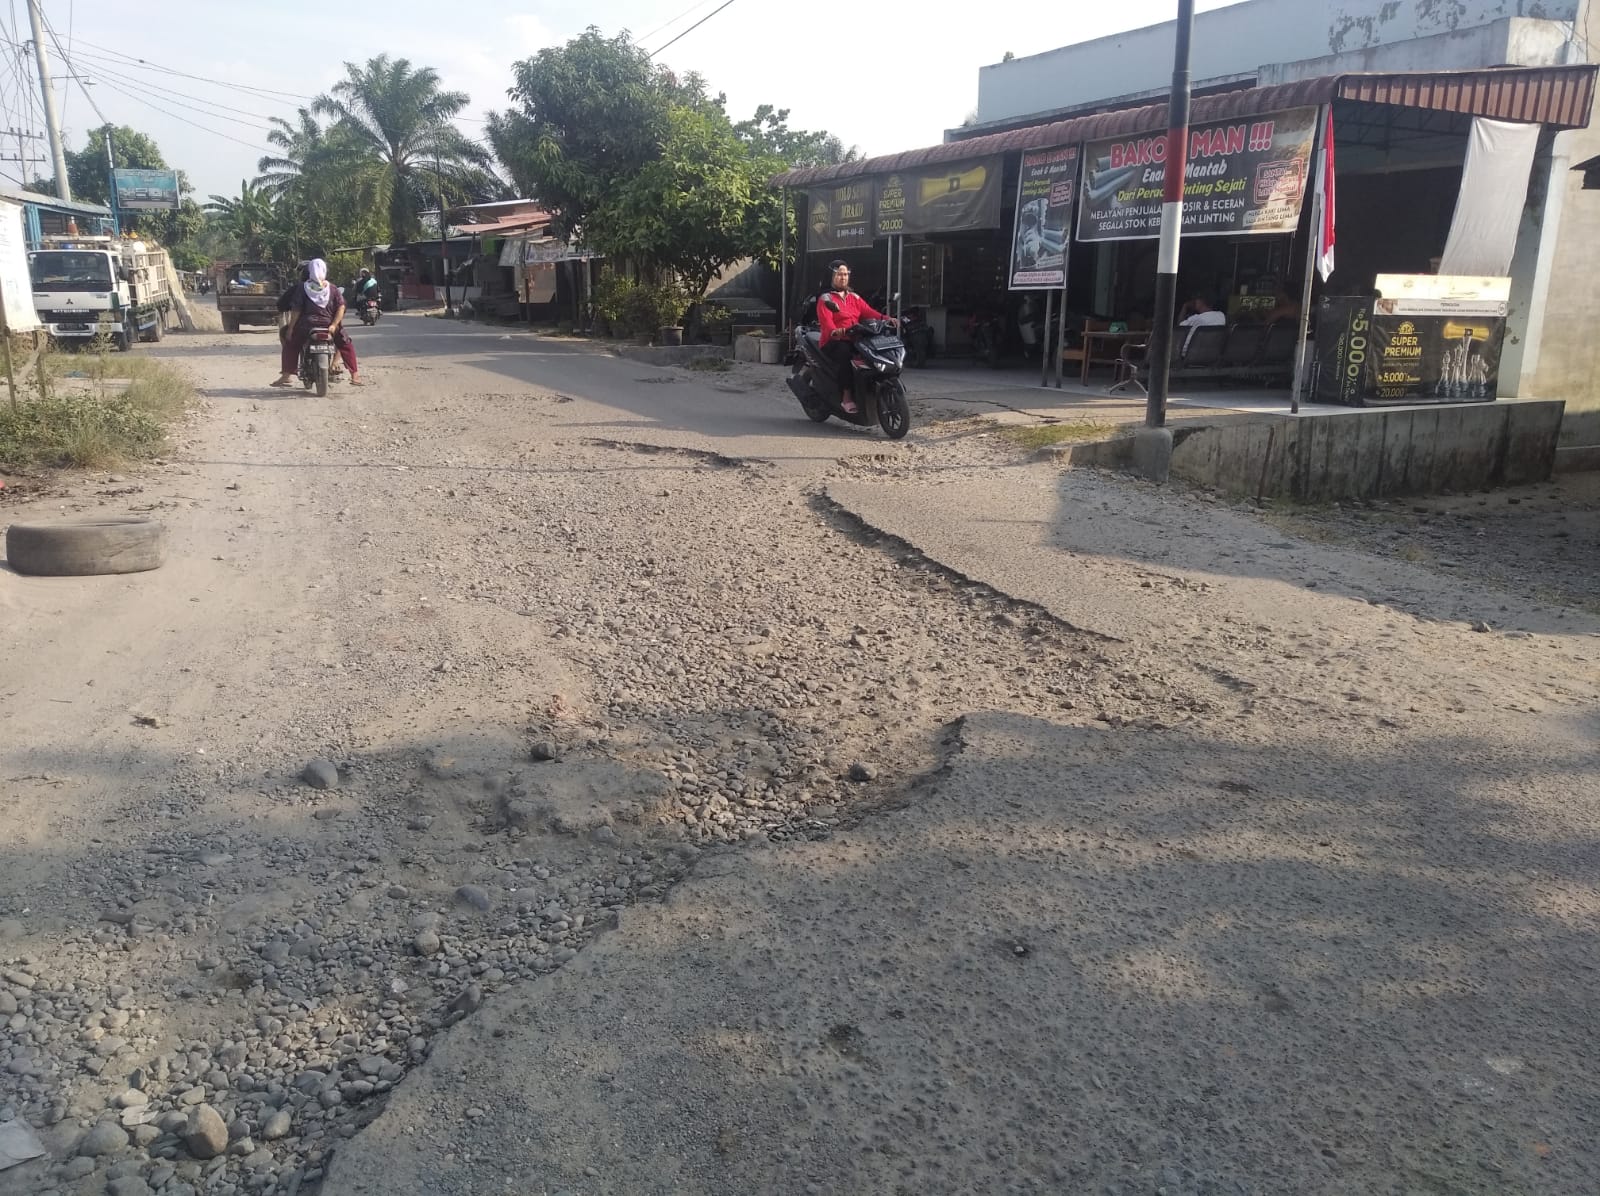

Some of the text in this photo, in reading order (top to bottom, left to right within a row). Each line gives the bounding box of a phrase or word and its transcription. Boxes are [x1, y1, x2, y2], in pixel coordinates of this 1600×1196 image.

[1190, 124, 1246, 159] MAN
[1185, 159, 1227, 178] Mantab
[1117, 188, 1136, 202] Dari
[1136, 187, 1166, 200] Perac
[1183, 181, 1213, 196] inting
[1214, 177, 1247, 194] Sejati
[879, 198, 905, 209] PREMIUM
[1090, 197, 1245, 220] MELAYANI PENJUALA OSIR & ECERAN
[1098, 220, 1124, 231] SEGALA
[1125, 218, 1146, 229] STOK
[1199, 212, 1235, 224] LINTING
[1391, 336, 1418, 346] SUPER
[1384, 347, 1422, 357] PREMIUM
